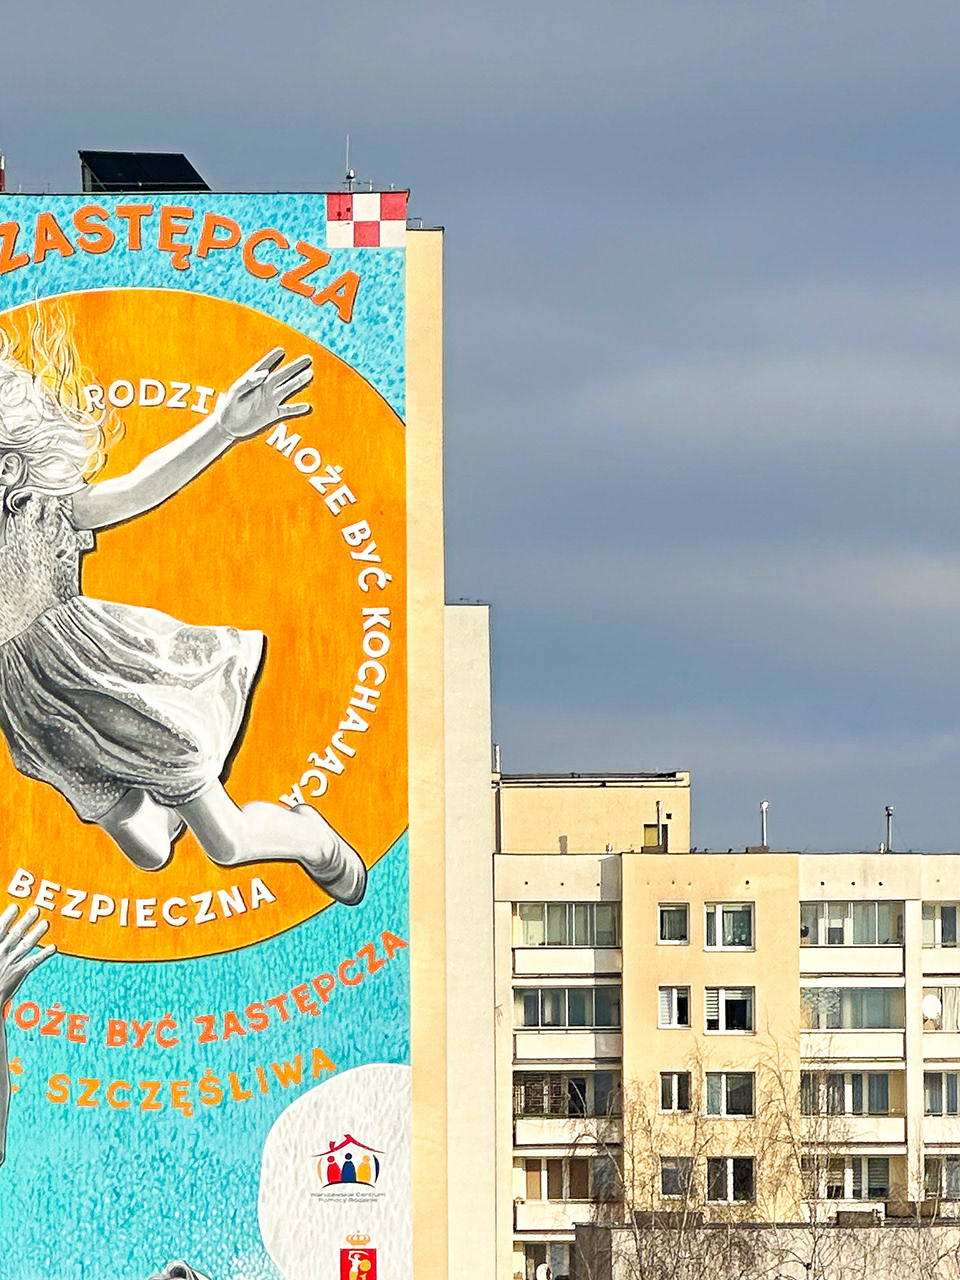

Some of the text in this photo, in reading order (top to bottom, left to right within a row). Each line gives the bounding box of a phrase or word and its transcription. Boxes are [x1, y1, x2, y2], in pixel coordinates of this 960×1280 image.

[265, 422, 357, 516] MOŻE
[341, 519, 393, 593] BYĆ
[279, 606, 391, 809] KOCHAJĄCA
[7, 858, 277, 928] BEZPIECZNA
[3, 997, 91, 1044] OŻE
[105, 1012, 180, 1048] BYĆ
[193, 930, 409, 1044] ZASTĘPCZA
[46, 1047, 339, 1117] SZCZĘŚLIWA
